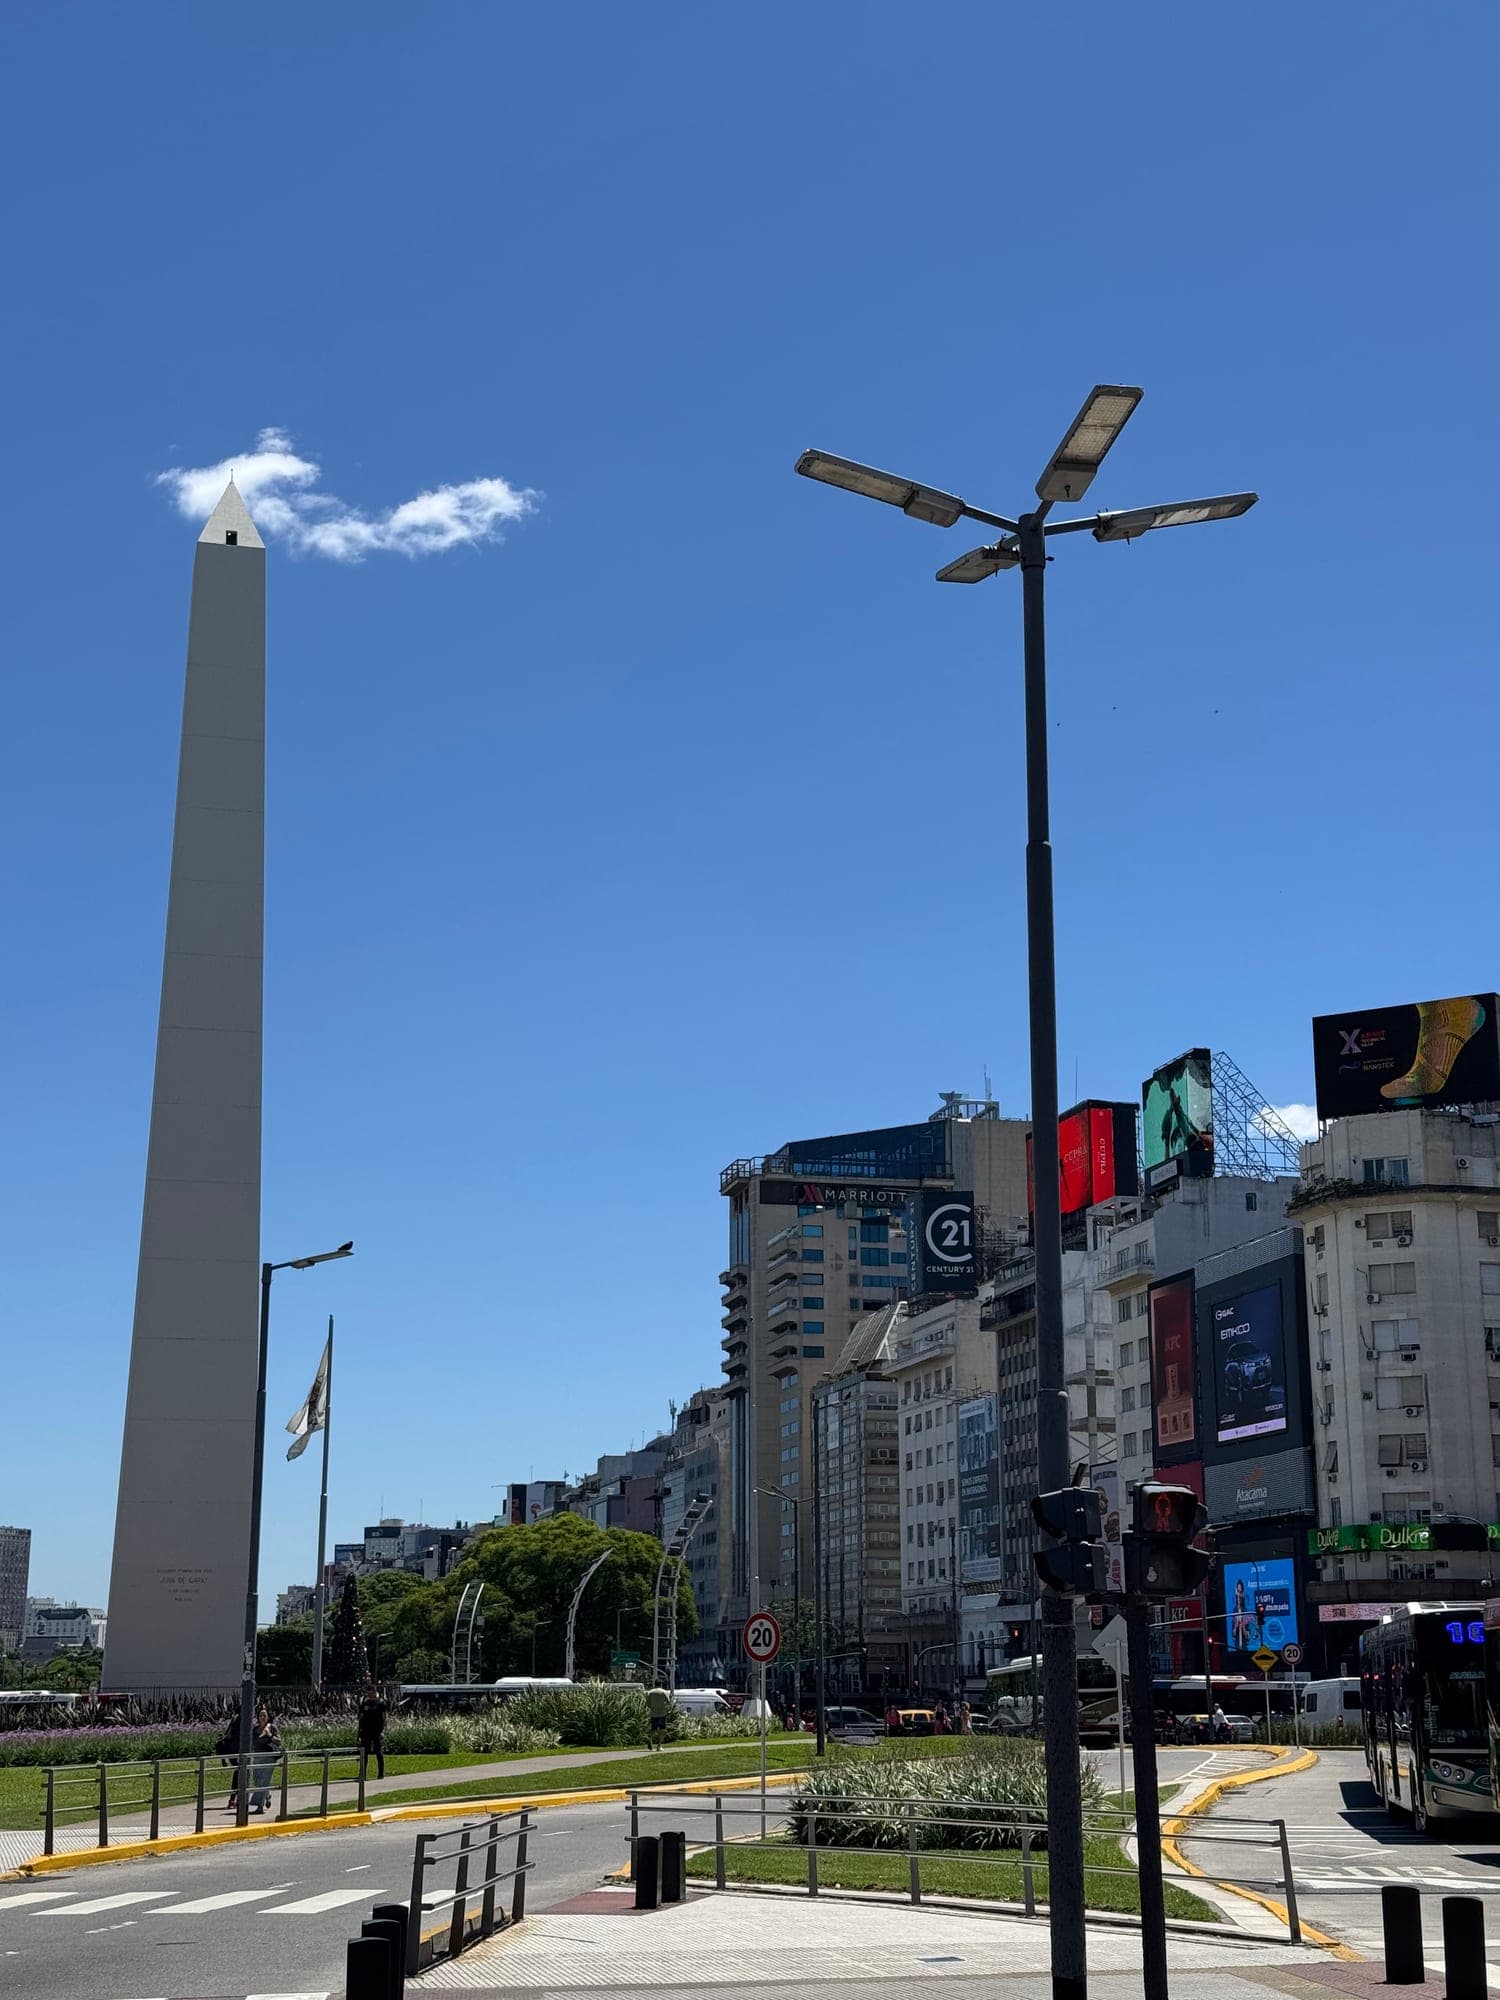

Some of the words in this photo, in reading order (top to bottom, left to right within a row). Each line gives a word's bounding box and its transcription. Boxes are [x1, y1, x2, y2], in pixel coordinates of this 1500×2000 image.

[825, 1189, 909, 1203] MARRIOTT
[926, 1265, 964, 1273] CENTURY
[1236, 1487, 1268, 1503] Atacama
[1171, 1606, 1189, 1620] KFC
[751, 1627, 772, 1647] 20
[1286, 1649, 1298, 1658] 20
